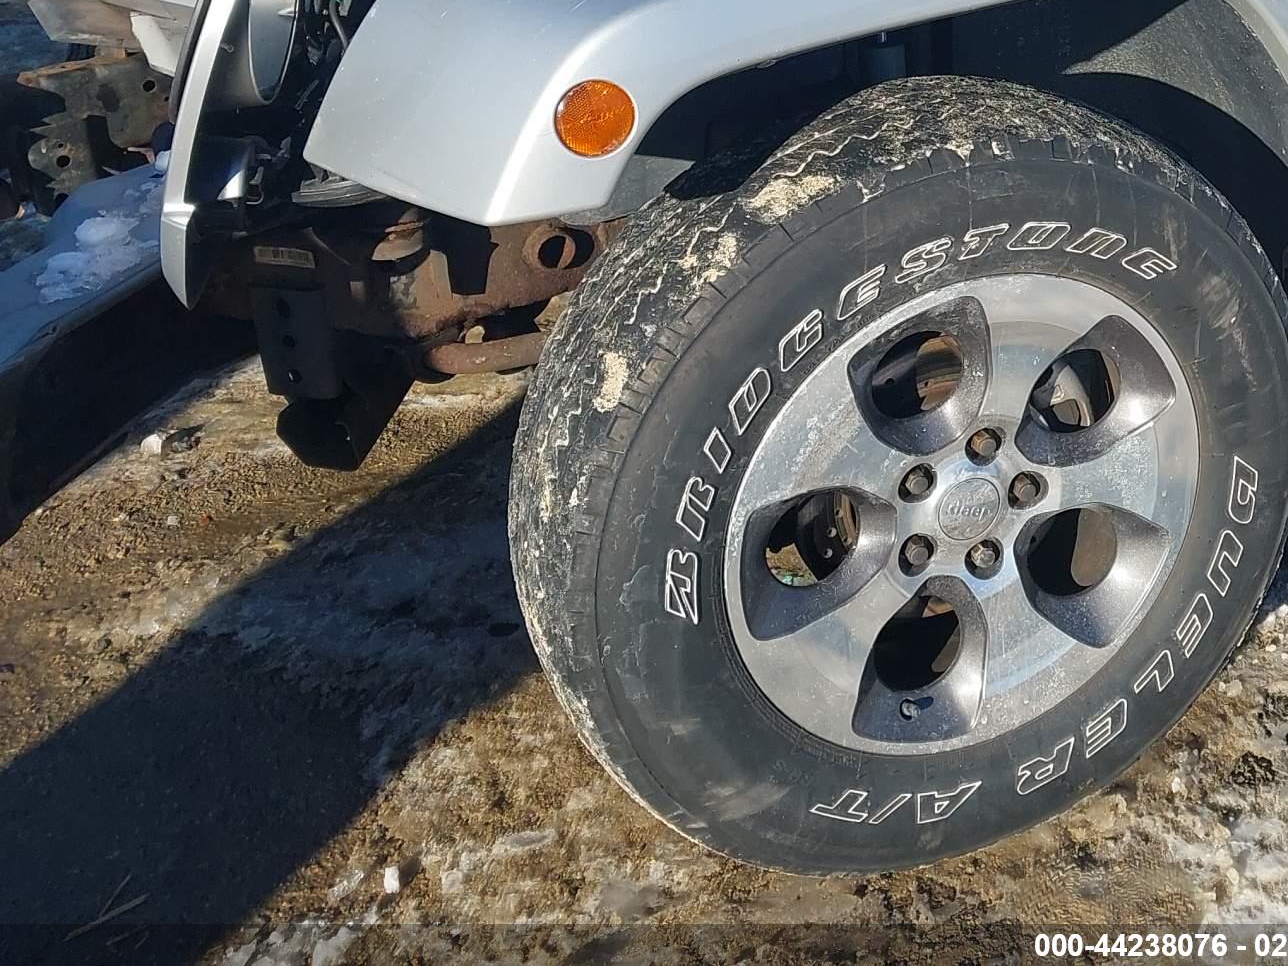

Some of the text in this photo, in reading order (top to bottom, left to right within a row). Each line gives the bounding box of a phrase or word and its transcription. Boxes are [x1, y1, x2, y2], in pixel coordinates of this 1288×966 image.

[664, 220, 1179, 627] BRIDGESTONE
[1016, 455, 1259, 796] DUELER
[808, 779, 980, 825] A/T
